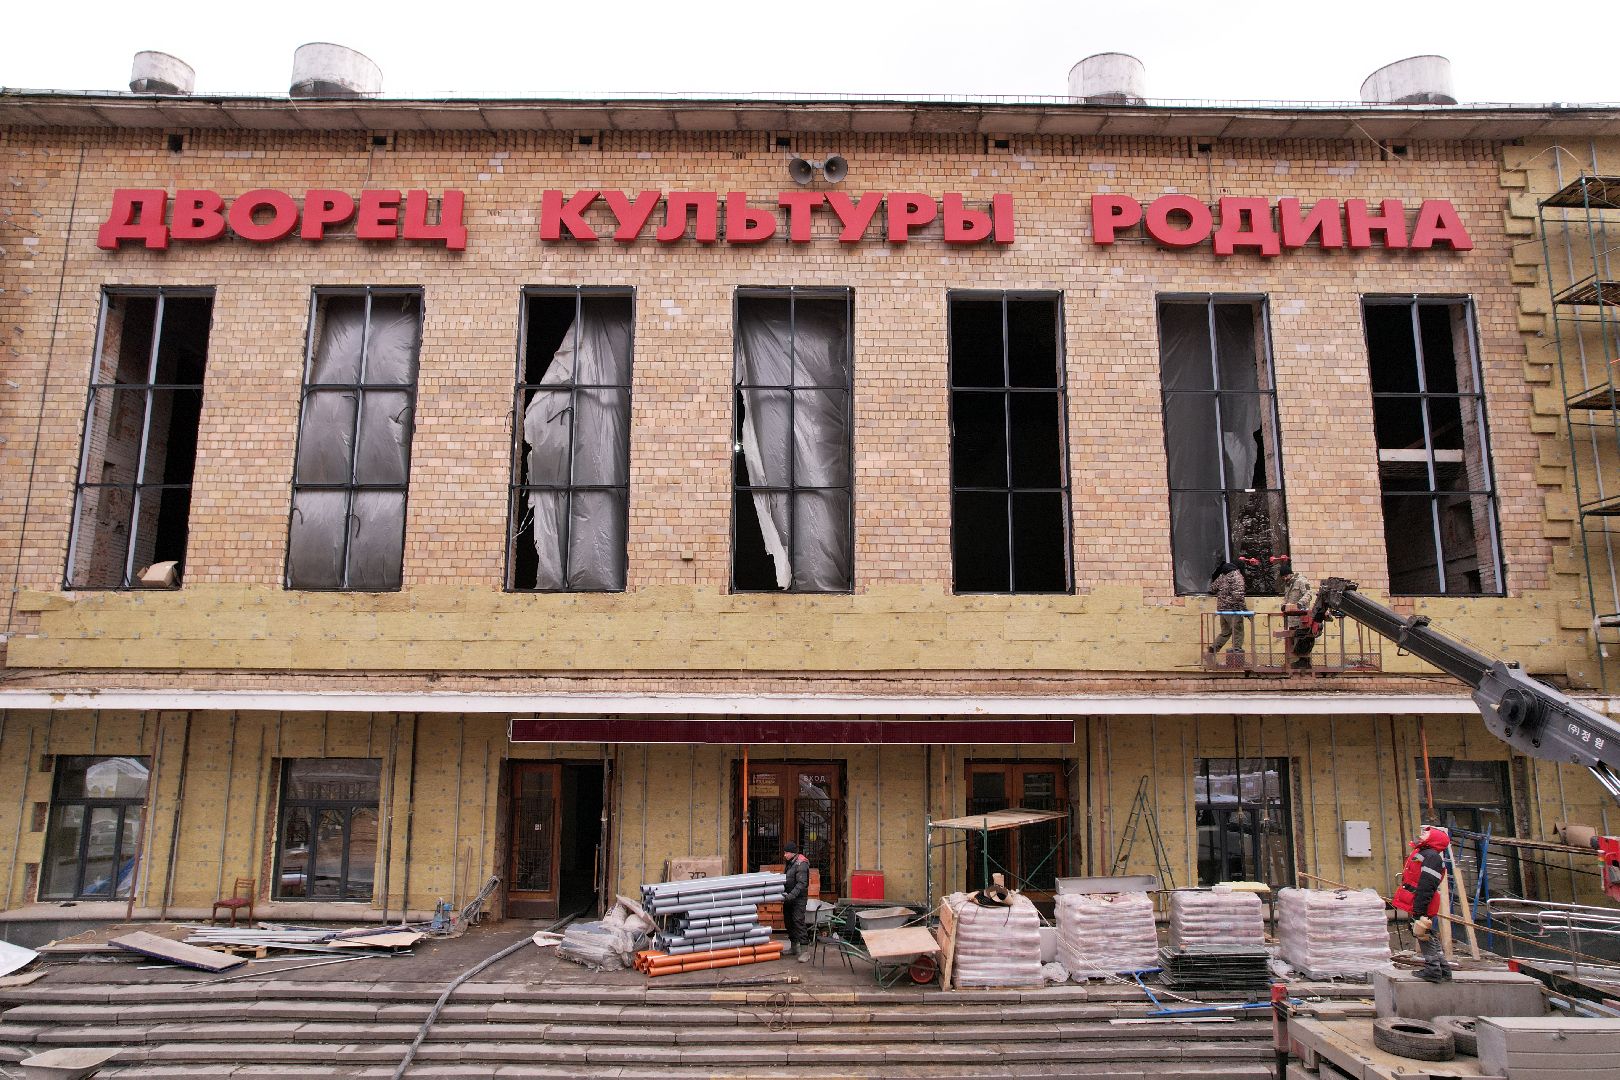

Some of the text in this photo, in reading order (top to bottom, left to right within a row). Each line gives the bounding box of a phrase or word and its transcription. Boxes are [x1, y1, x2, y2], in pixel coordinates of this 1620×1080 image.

[96, 188, 1474, 257] ДВОРЕЦ КУЛЬТУРЫ РОДИНА
[803, 775, 826, 783] ВХОД
